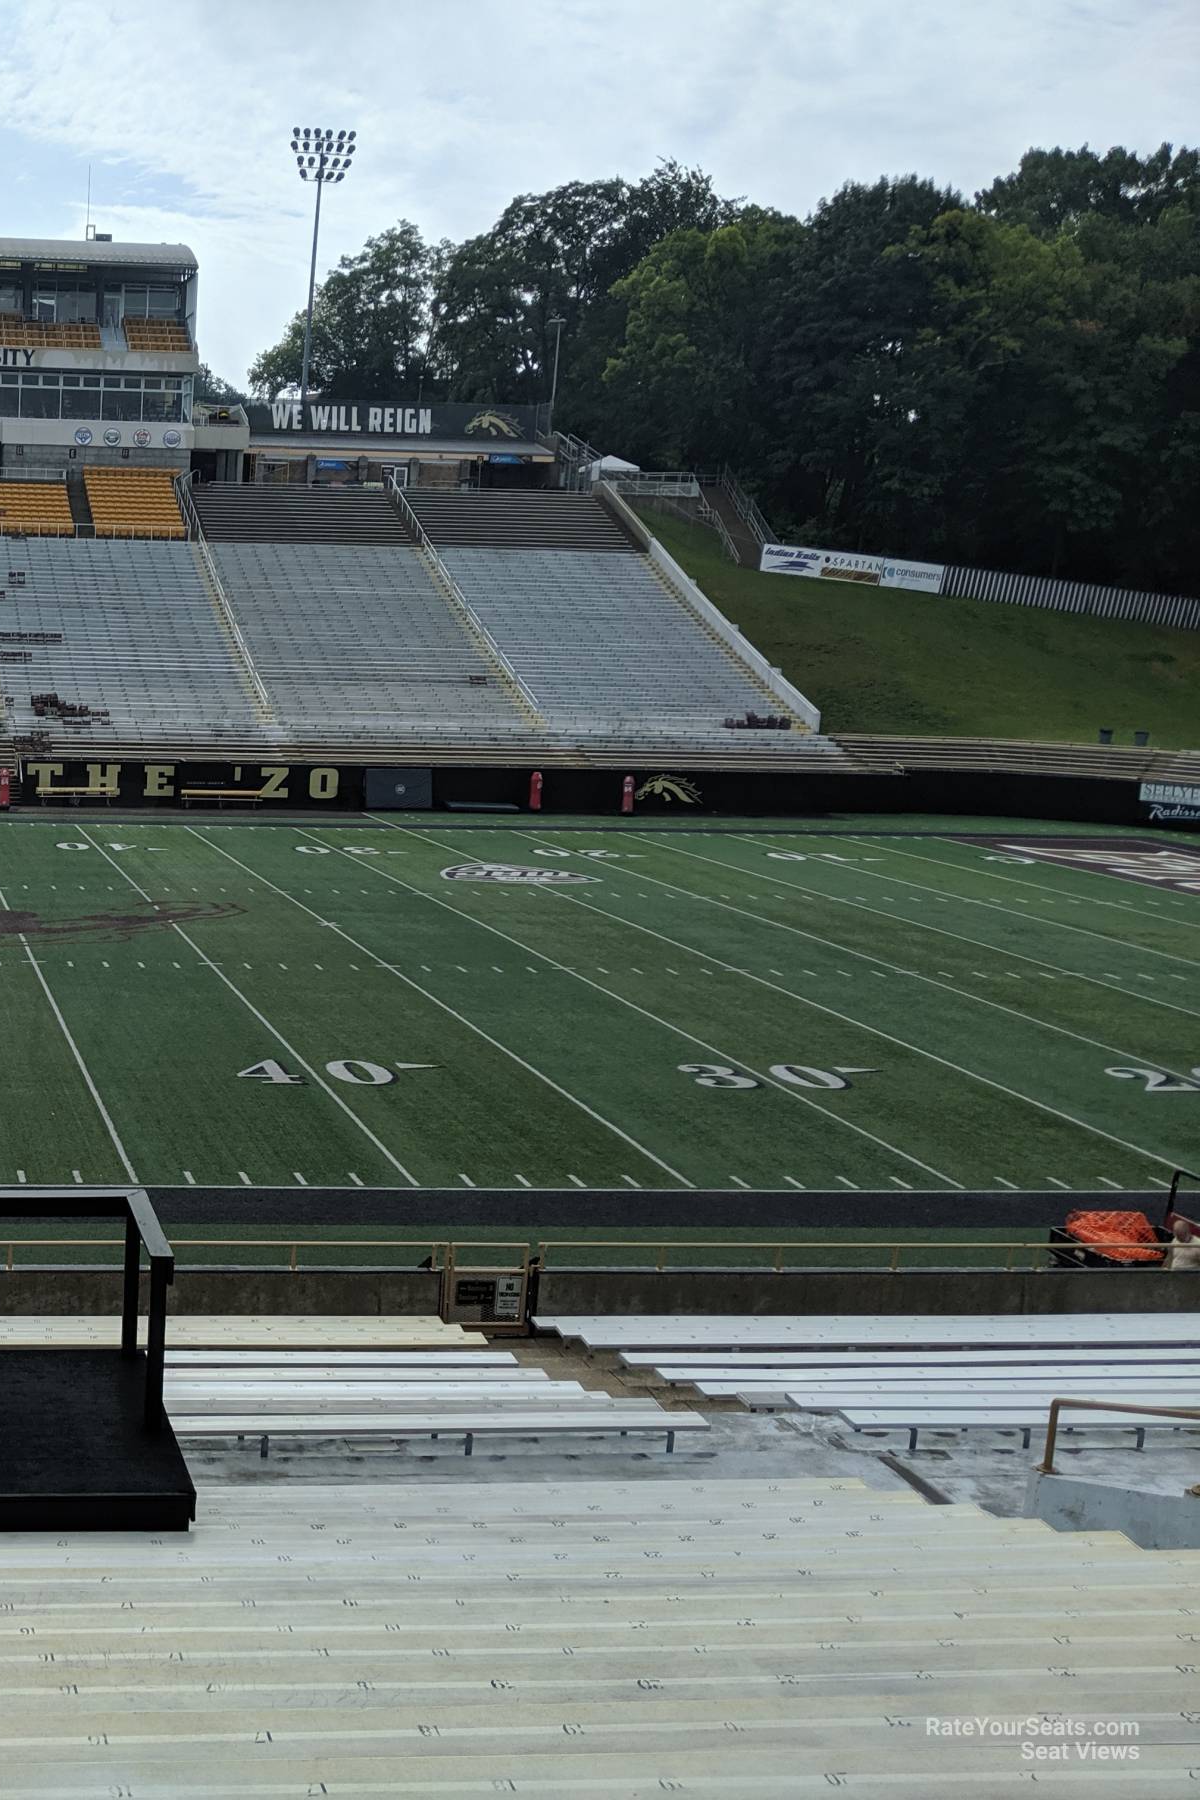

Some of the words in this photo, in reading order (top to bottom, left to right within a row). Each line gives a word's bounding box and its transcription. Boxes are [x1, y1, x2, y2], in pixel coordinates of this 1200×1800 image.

[272, 404, 302, 430] WE
[310, 405, 362, 431] WILL
[368, 407, 432, 434] REIGN
[765, 547, 795, 558] Indian
[796, 550, 821, 561] Trails
[832, 557, 883, 572] SPARTAN
[896, 568, 942, 581] consumers
[28, 763, 175, 797] THE
[236, 1058, 396, 1084] 40
[677, 1064, 846, 1089] 30
[1104, 1067, 1200, 1091] 2
